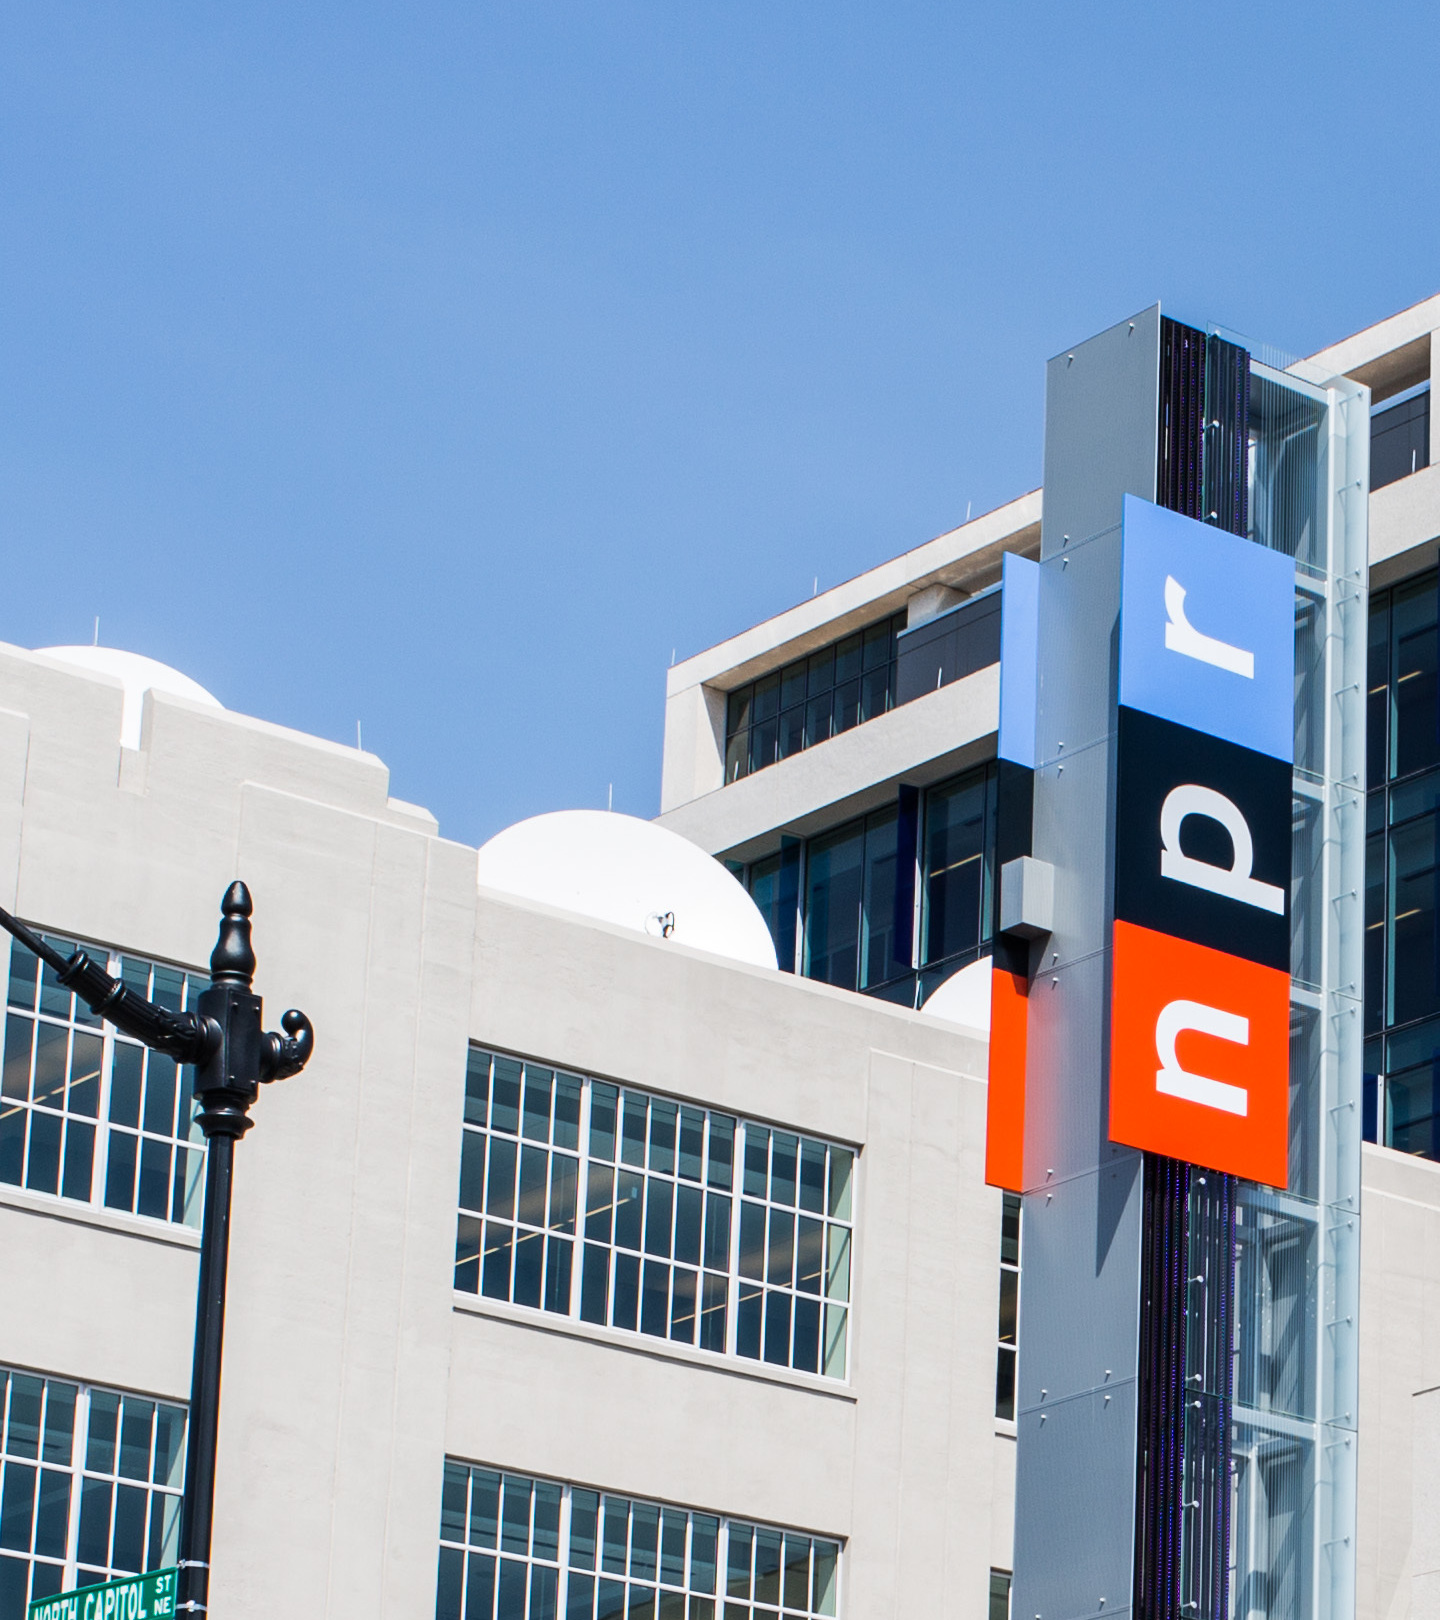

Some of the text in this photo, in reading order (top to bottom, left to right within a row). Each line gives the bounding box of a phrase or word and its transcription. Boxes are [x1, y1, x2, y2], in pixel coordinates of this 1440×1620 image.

[1155, 573, 1285, 1117] npr
[155, 1574, 172, 1594] ST
[154, 1596, 172, 1616] NE
